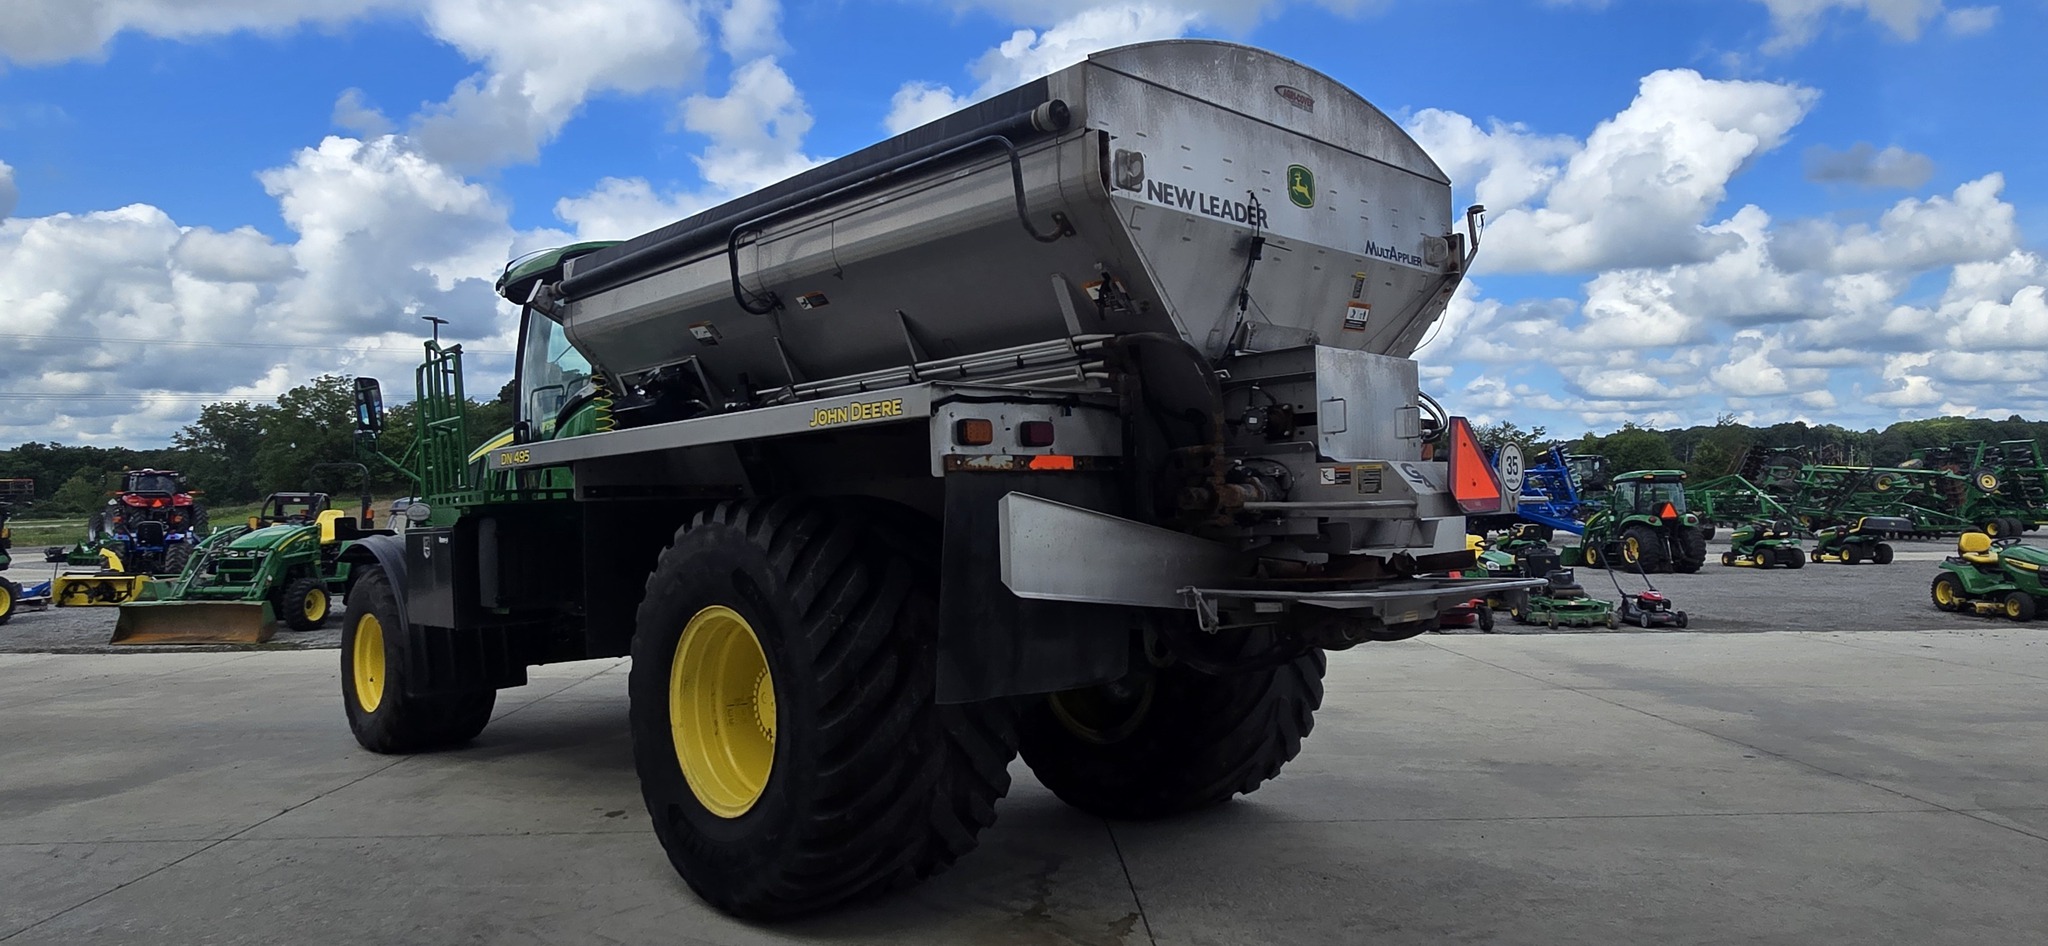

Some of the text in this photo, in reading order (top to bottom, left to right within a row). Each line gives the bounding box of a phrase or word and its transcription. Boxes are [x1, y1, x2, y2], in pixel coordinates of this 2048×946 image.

[1147, 179, 1268, 229] NEW LEADER
[809, 398, 903, 428] JOHN DEERE
[500, 449, 530, 465] DN 495
[1506, 455, 1518, 475] 35
